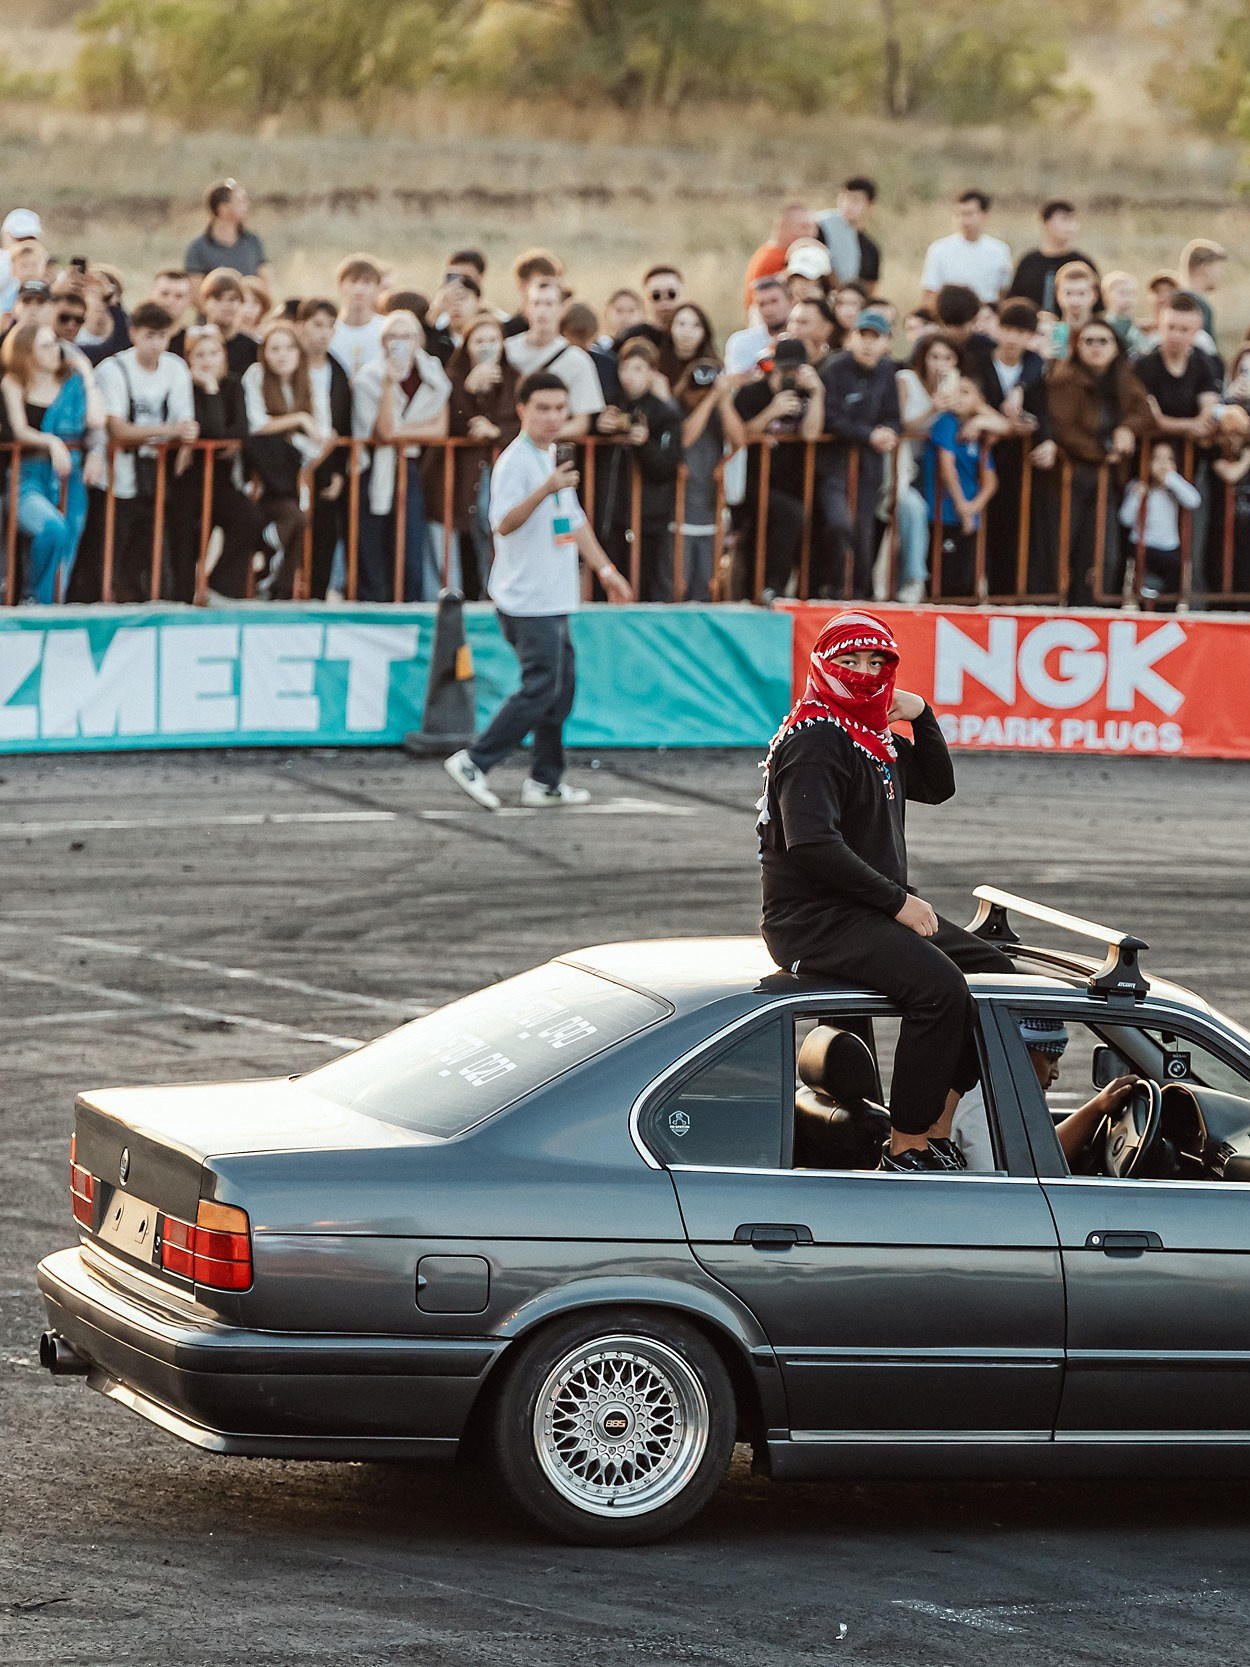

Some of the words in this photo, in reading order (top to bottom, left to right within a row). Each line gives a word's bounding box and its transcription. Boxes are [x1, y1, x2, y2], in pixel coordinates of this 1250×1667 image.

[934, 615, 1187, 717] NGK
[938, 713, 1054, 747] SPARK
[1060, 718, 1183, 752] PLUGS
[605, 1419, 626, 1428] BBS
